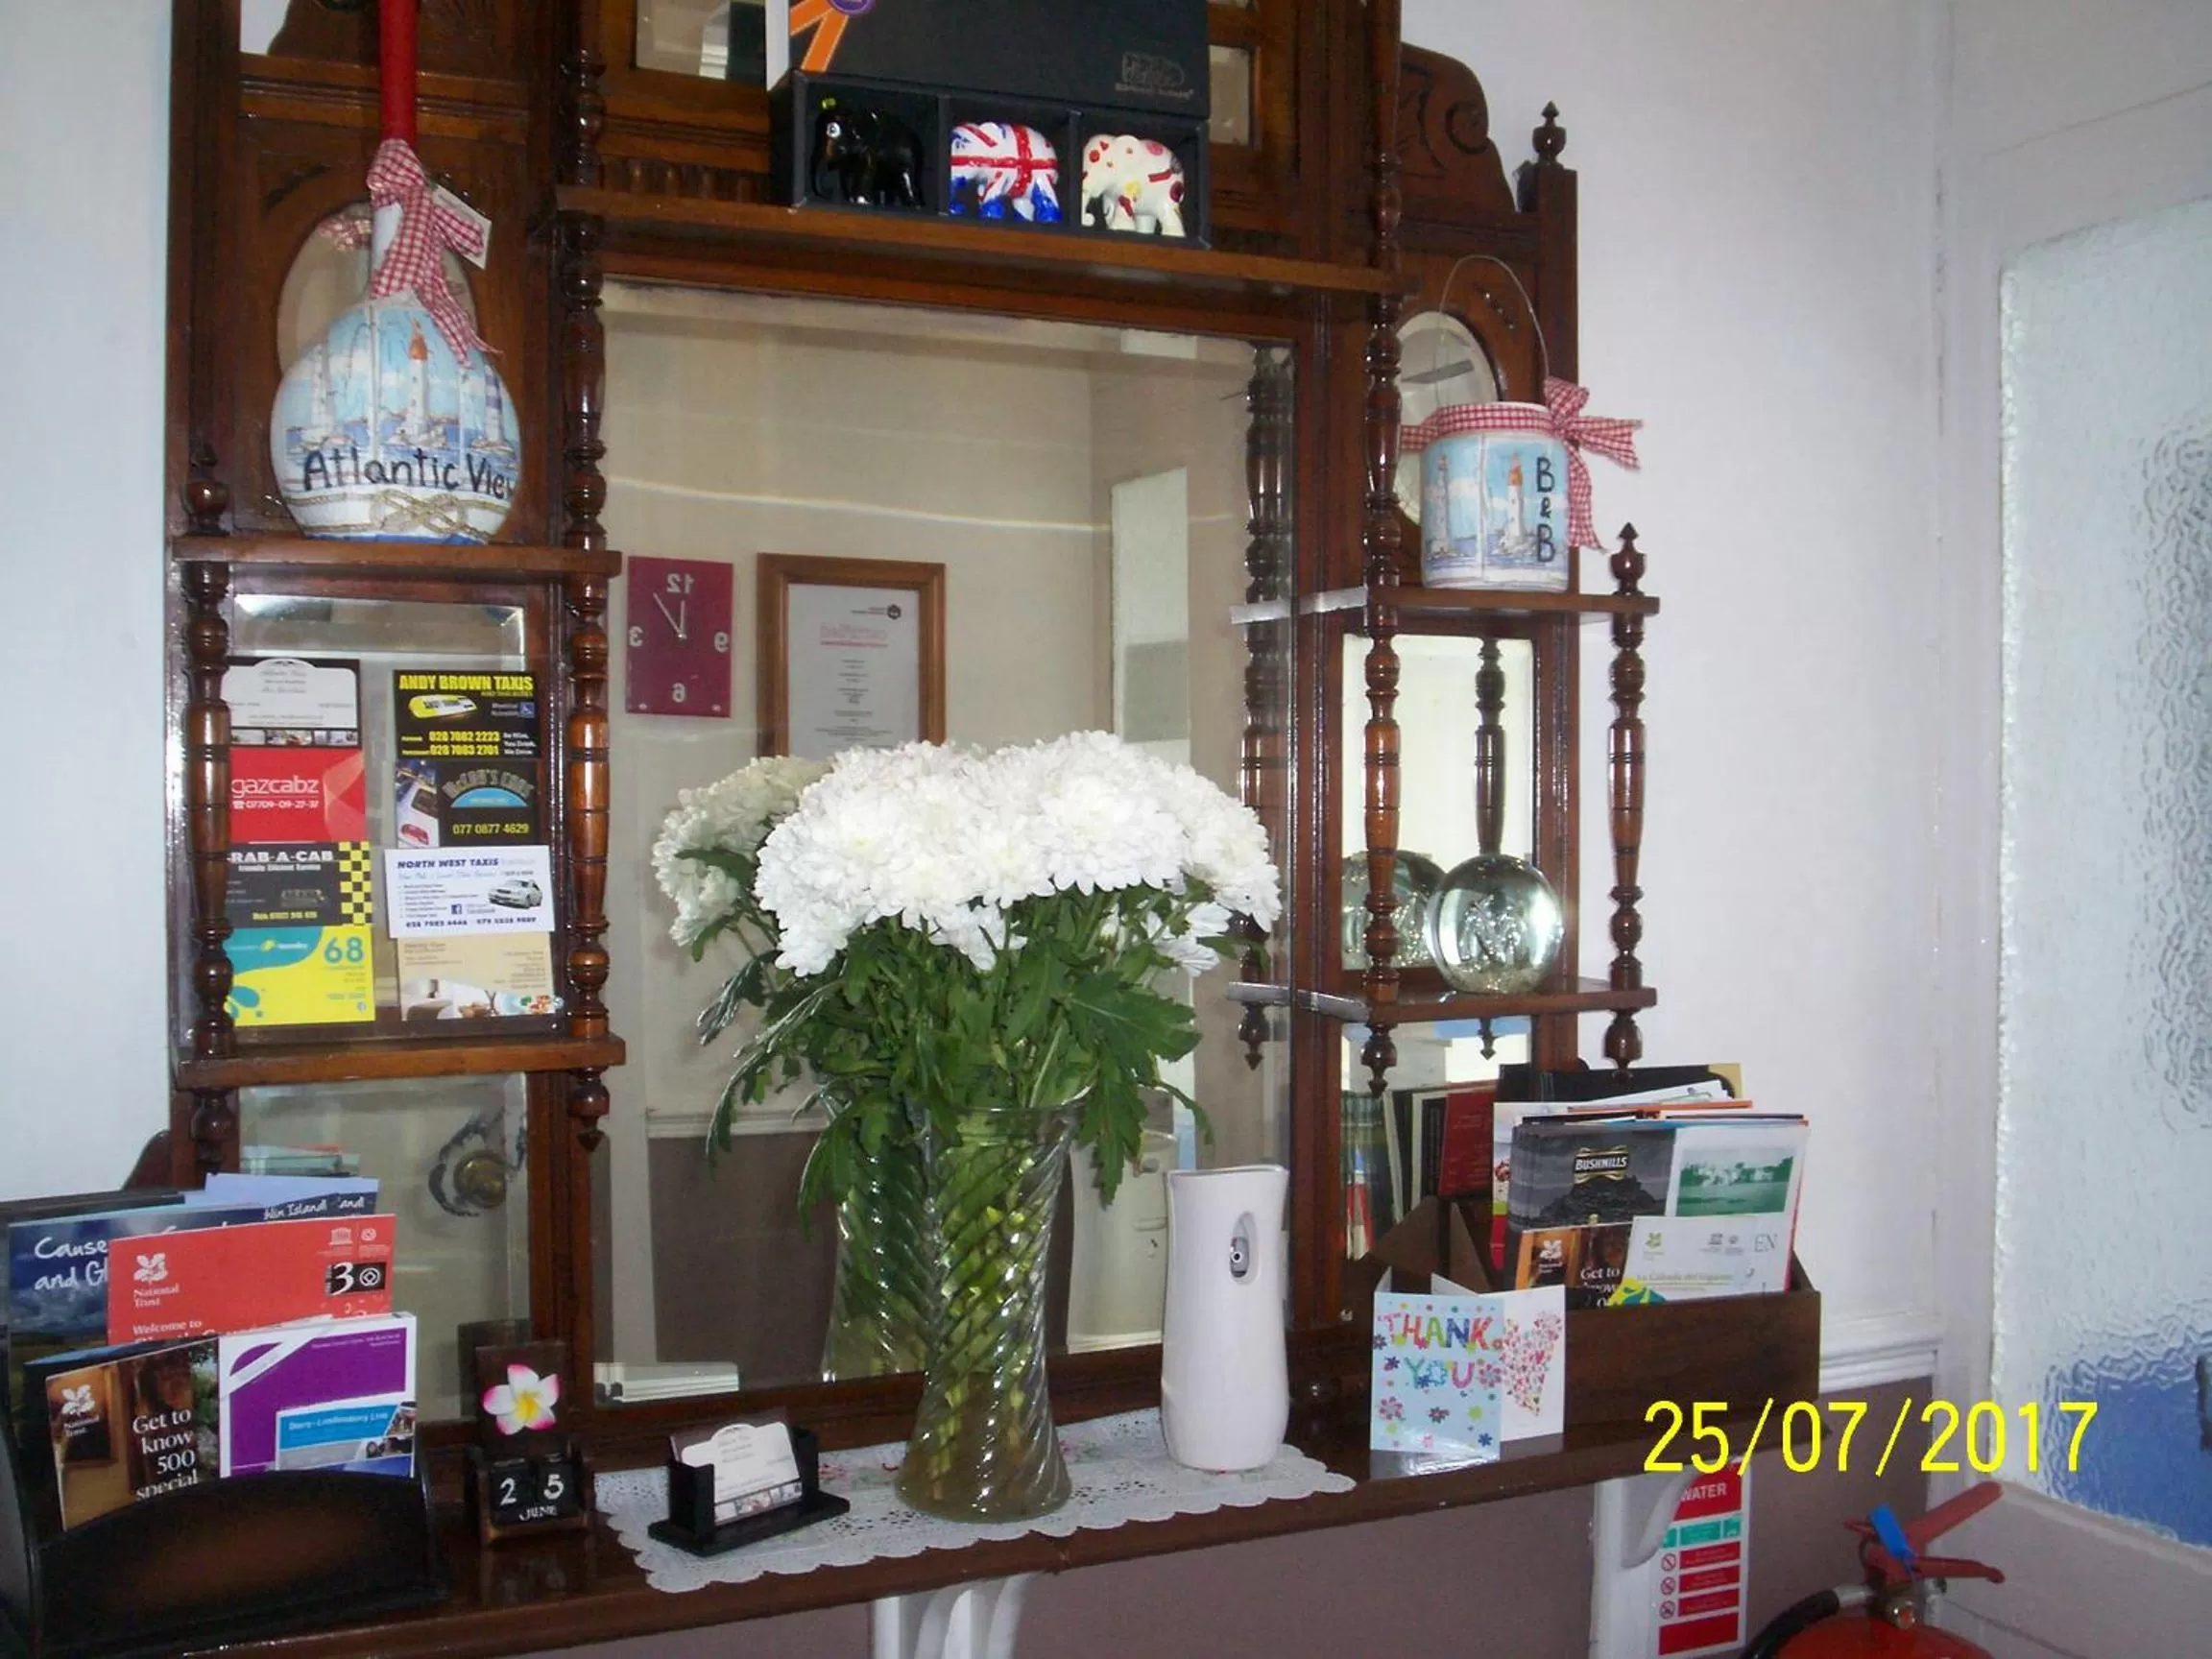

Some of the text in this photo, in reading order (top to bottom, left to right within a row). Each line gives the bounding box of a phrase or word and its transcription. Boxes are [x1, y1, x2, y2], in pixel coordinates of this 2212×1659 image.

[303, 446, 460, 492] Atlantic
[1536, 456, 1555, 493] B
[1537, 523, 1556, 564] B
[399, 675, 534, 690] ANDY BROWN TAXIS
[230, 775, 320, 799] gazcabz
[452, 824, 471, 834] 077
[227, 851, 333, 863] RAB-A-CAB
[397, 860, 435, 869] NORTH
[469, 857, 499, 866] TAXIS
[325, 935, 363, 963] 68
[1575, 1157, 1628, 1170] BUSHMILLS
[35, 1266, 80, 1291] and
[1580, 1267, 1620, 1279] Get to
[133, 1283, 180, 1297] National
[133, 1297, 160, 1309] Trust
[132, 1321, 186, 1335] Welcome
[1378, 1312, 1494, 1351] THANK
[1405, 1357, 1475, 1389] YOU
[132, 1408, 192, 1434] Get to
[141, 1430, 194, 1455] know
[156, 1450, 196, 1475] 500
[135, 1469, 199, 1502] special
[500, 1478, 517, 1505] 2
[543, 1474, 565, 1500] 5
[518, 1505, 557, 1521] JUNE
